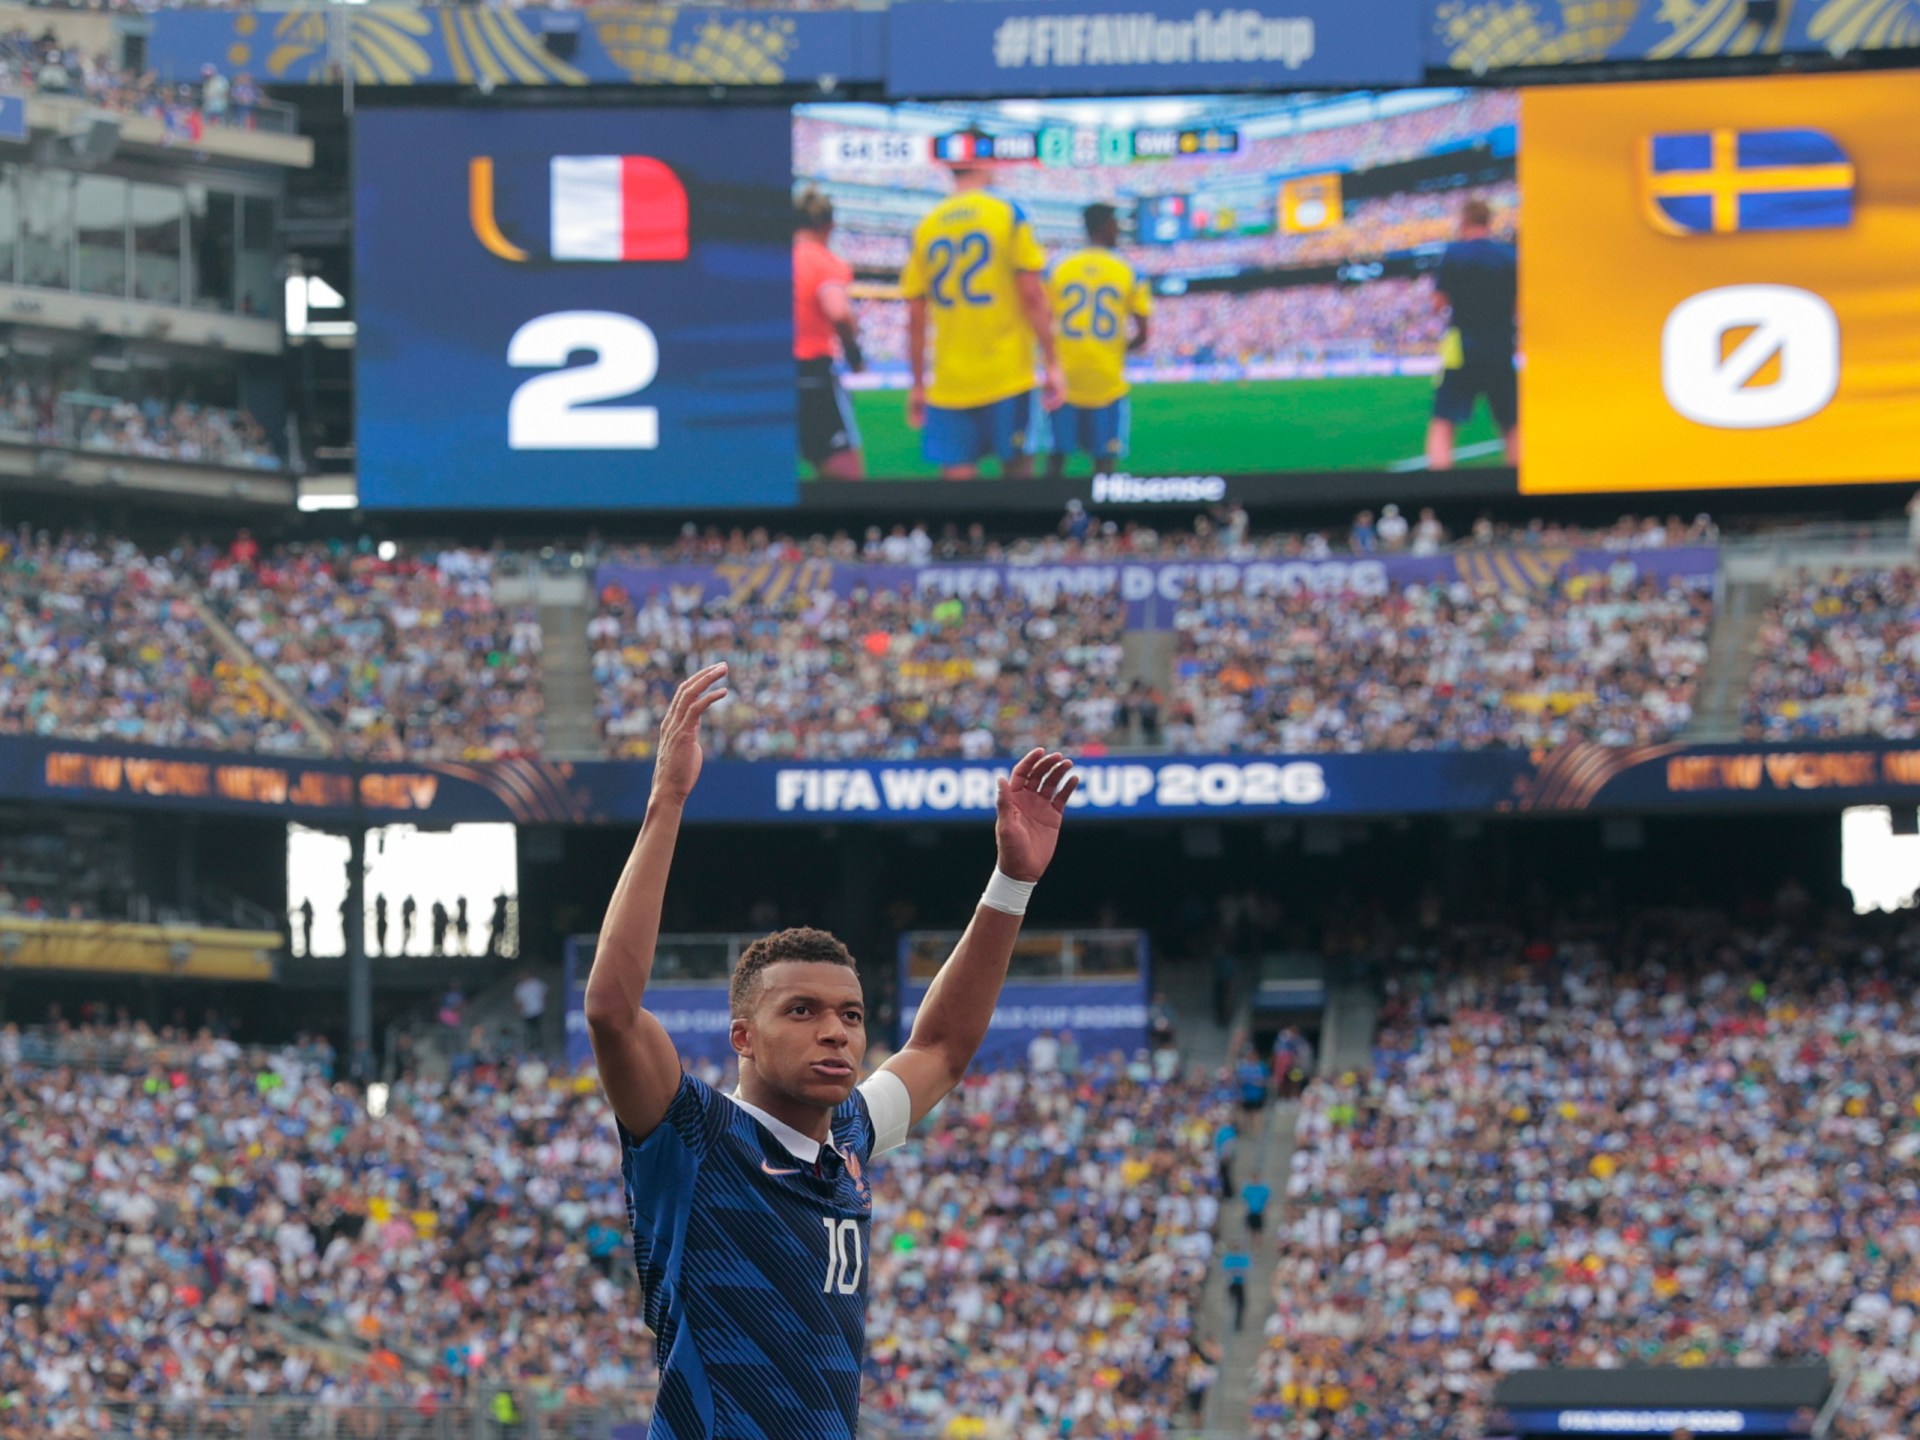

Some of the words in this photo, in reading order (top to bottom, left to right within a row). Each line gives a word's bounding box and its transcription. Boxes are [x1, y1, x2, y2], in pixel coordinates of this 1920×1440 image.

[993, 10, 1314, 69] #FIFAWorldCup
[929, 232, 993, 307] 22
[1062, 284, 1119, 339] 26
[507, 310, 659, 450] 2
[1662, 284, 1841, 429] 0
[1092, 473, 1226, 503] Hisense
[776, 769, 881, 811] FIFA
[880, 767, 1010, 810] WOR
[1156, 761, 1327, 806] 2026
[822, 1217, 862, 1295] 10
